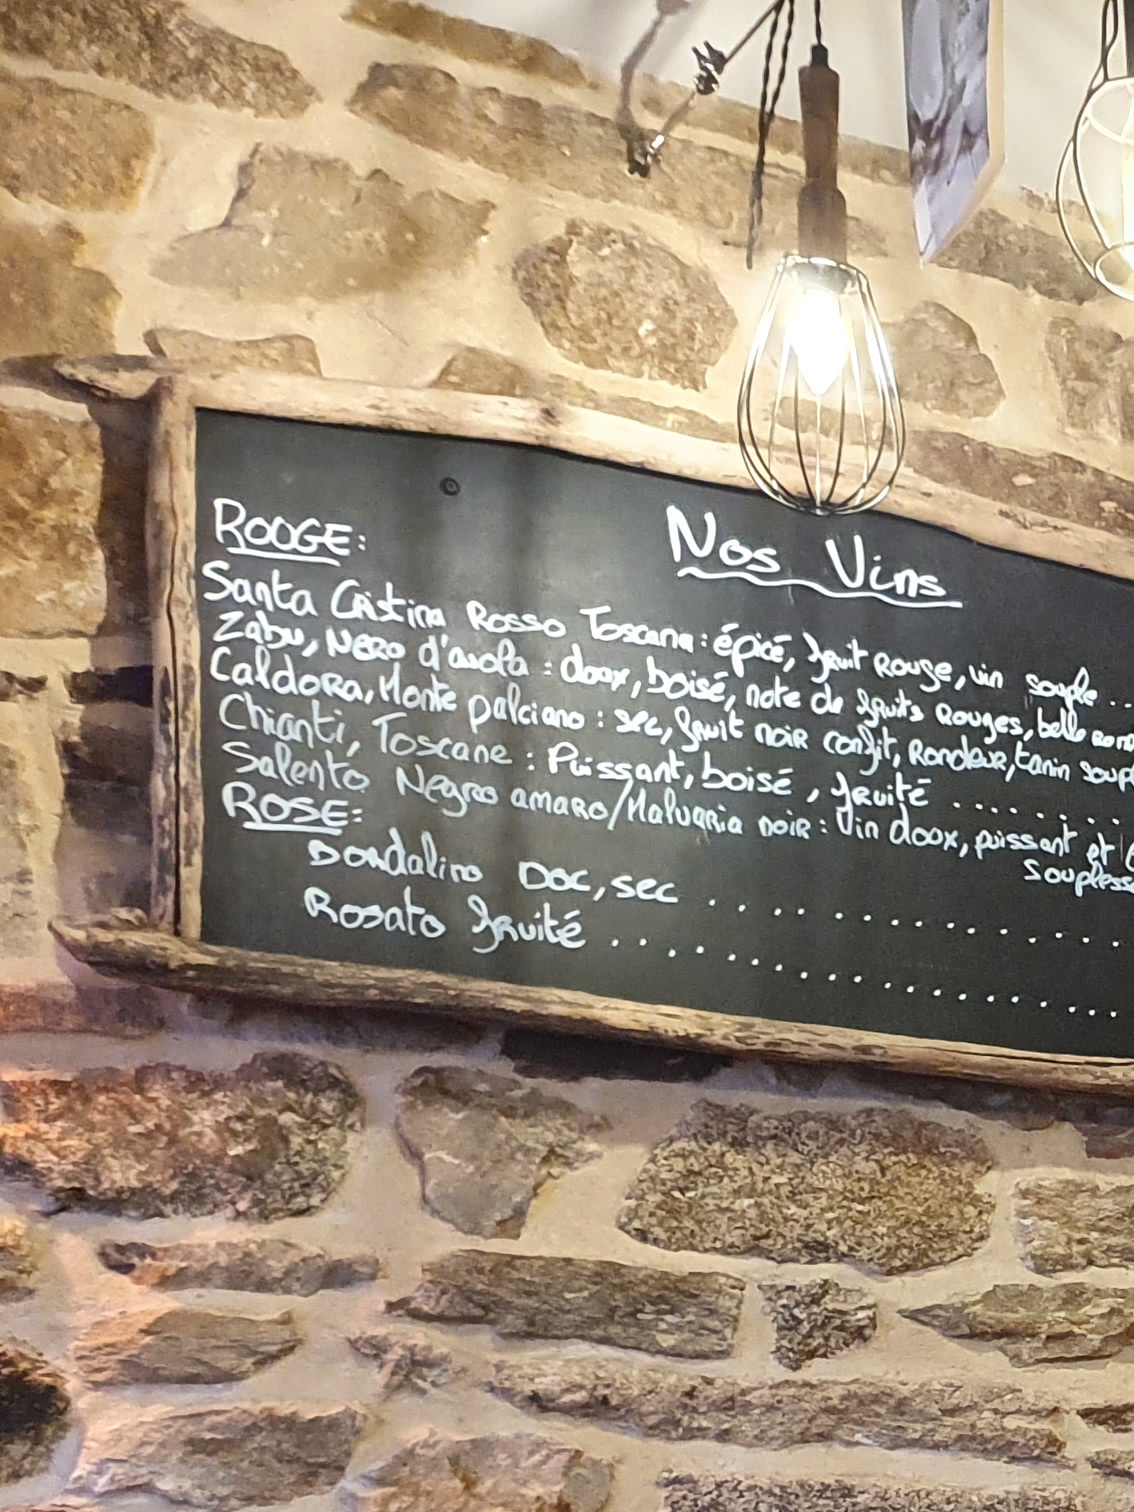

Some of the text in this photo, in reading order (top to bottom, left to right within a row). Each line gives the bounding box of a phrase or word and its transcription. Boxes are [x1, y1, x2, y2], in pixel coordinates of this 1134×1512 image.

[666, 504, 947, 598] Nos Vins
[202, 560, 318, 617] Santa
[466, 601, 567, 638] Rosso
[746, 675, 801, 709] note
[810, 683, 844, 715] de
[372, 712, 512, 765] Toscane
[1087, 832, 1115, 867] et
[611, 874, 679, 904] sec
[303, 885, 447, 938] Rosato
[467, 894, 586, 954] fruité
